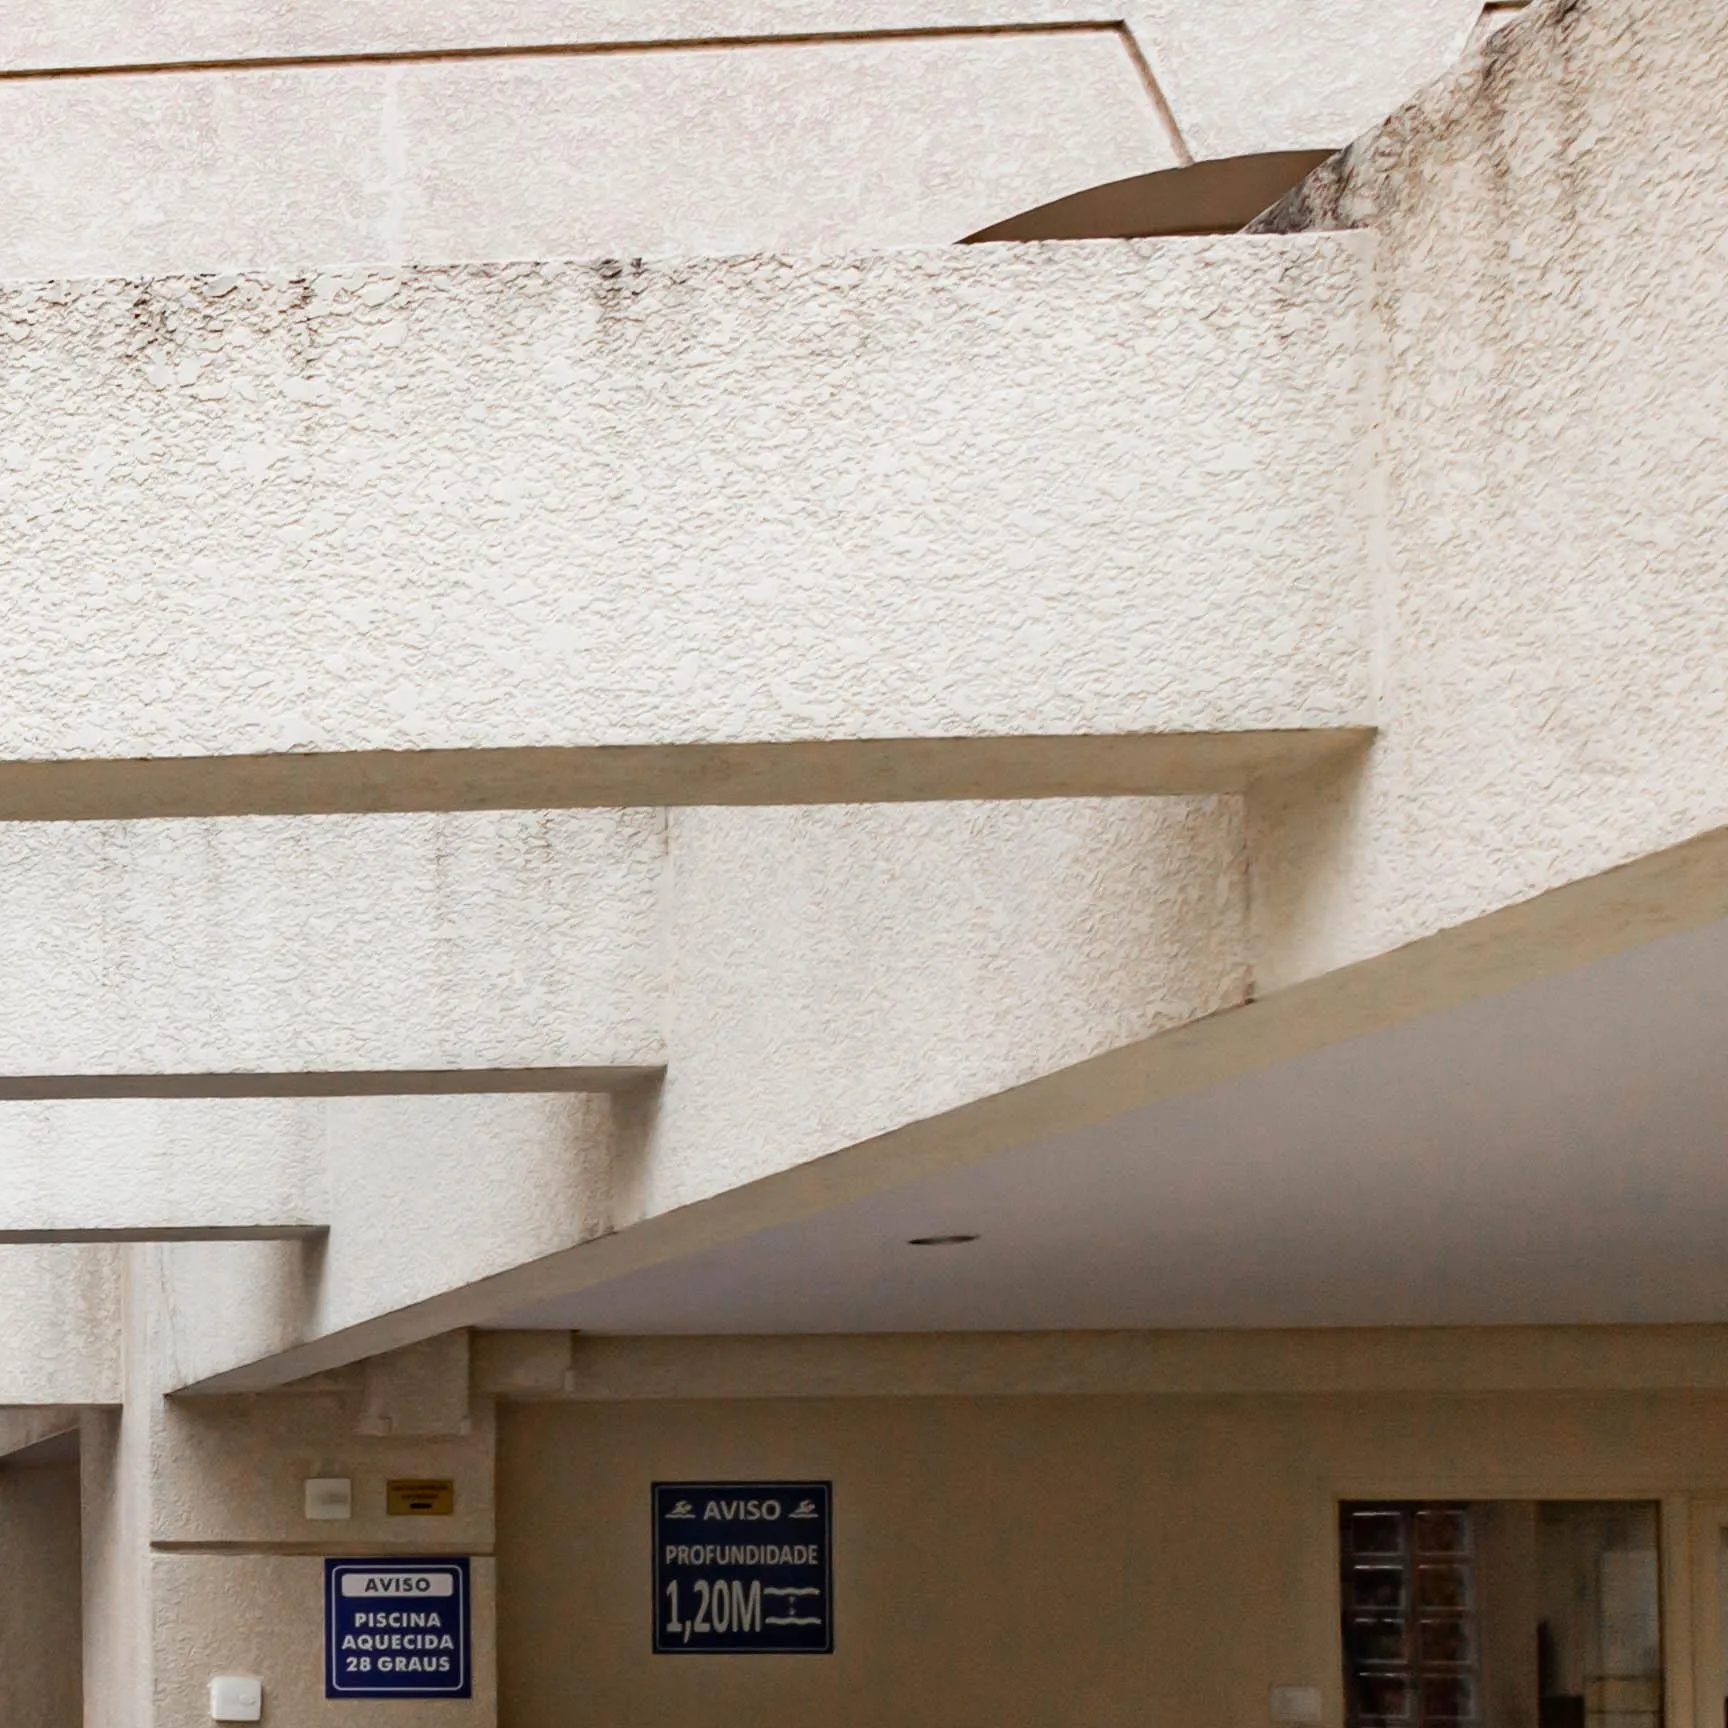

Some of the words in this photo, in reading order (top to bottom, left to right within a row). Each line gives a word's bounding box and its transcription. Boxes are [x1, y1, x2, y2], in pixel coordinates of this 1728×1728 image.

[703, 1499, 782, 1521] AVISO
[665, 1544, 819, 1566] PROFUNDIDADE
[364, 1577, 431, 1593] AVISO
[354, 1611, 441, 1628] PISCINA
[666, 1578, 762, 1644] 1,20M
[341, 1634, 455, 1651] AQUECIDA
[346, 1656, 372, 1672] 28
[377, 1656, 451, 1672] GRAUS
